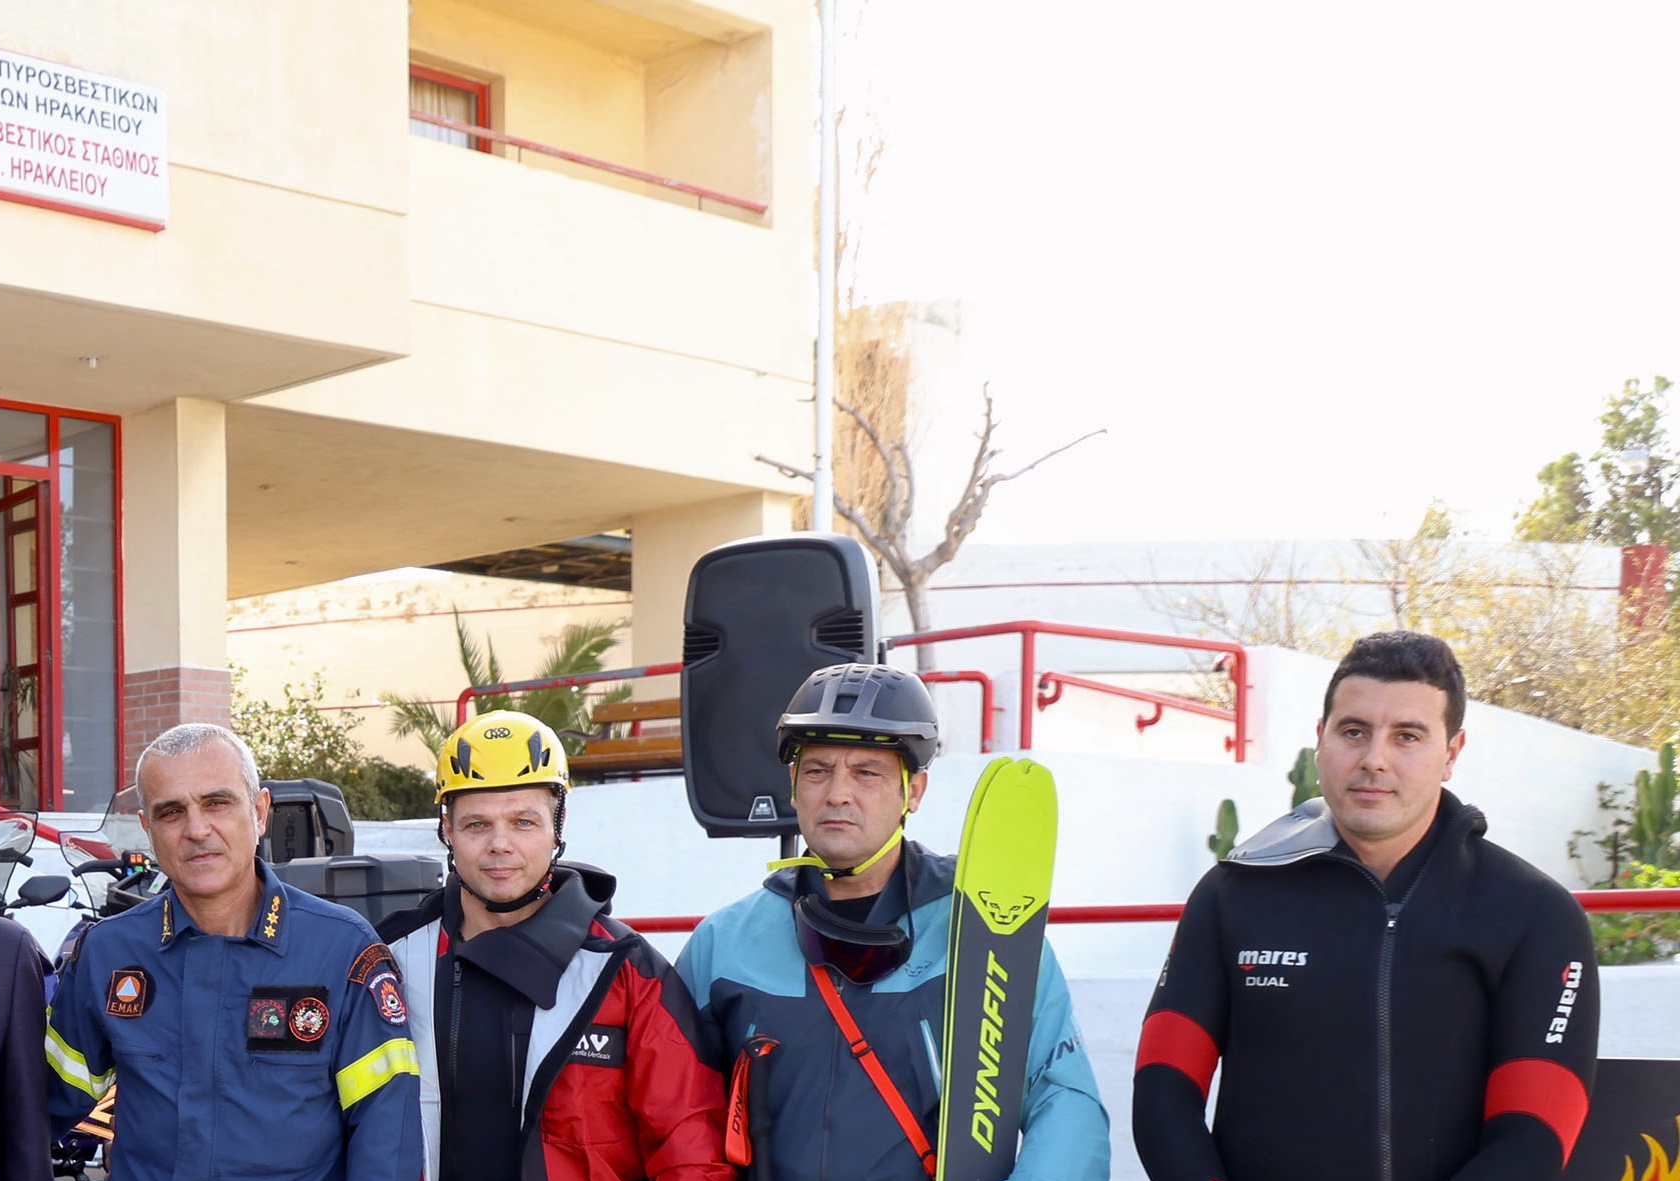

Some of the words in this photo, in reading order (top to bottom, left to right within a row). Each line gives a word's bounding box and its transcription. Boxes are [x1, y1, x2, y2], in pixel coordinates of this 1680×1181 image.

[36, 95, 142, 136] ΗΡΑΚΛΕΙΟΥ
[10, 156, 107, 198] ΗΡΑΚΛΕΙΟΥ
[82, 140, 159, 177] ΣΤΑΘΜΟΣ
[1237, 950, 1309, 966] mares
[1245, 976, 1290, 987] DUAL
[1545, 961, 1583, 1044] mares
[971, 949, 1009, 1154] DYNAFIT
